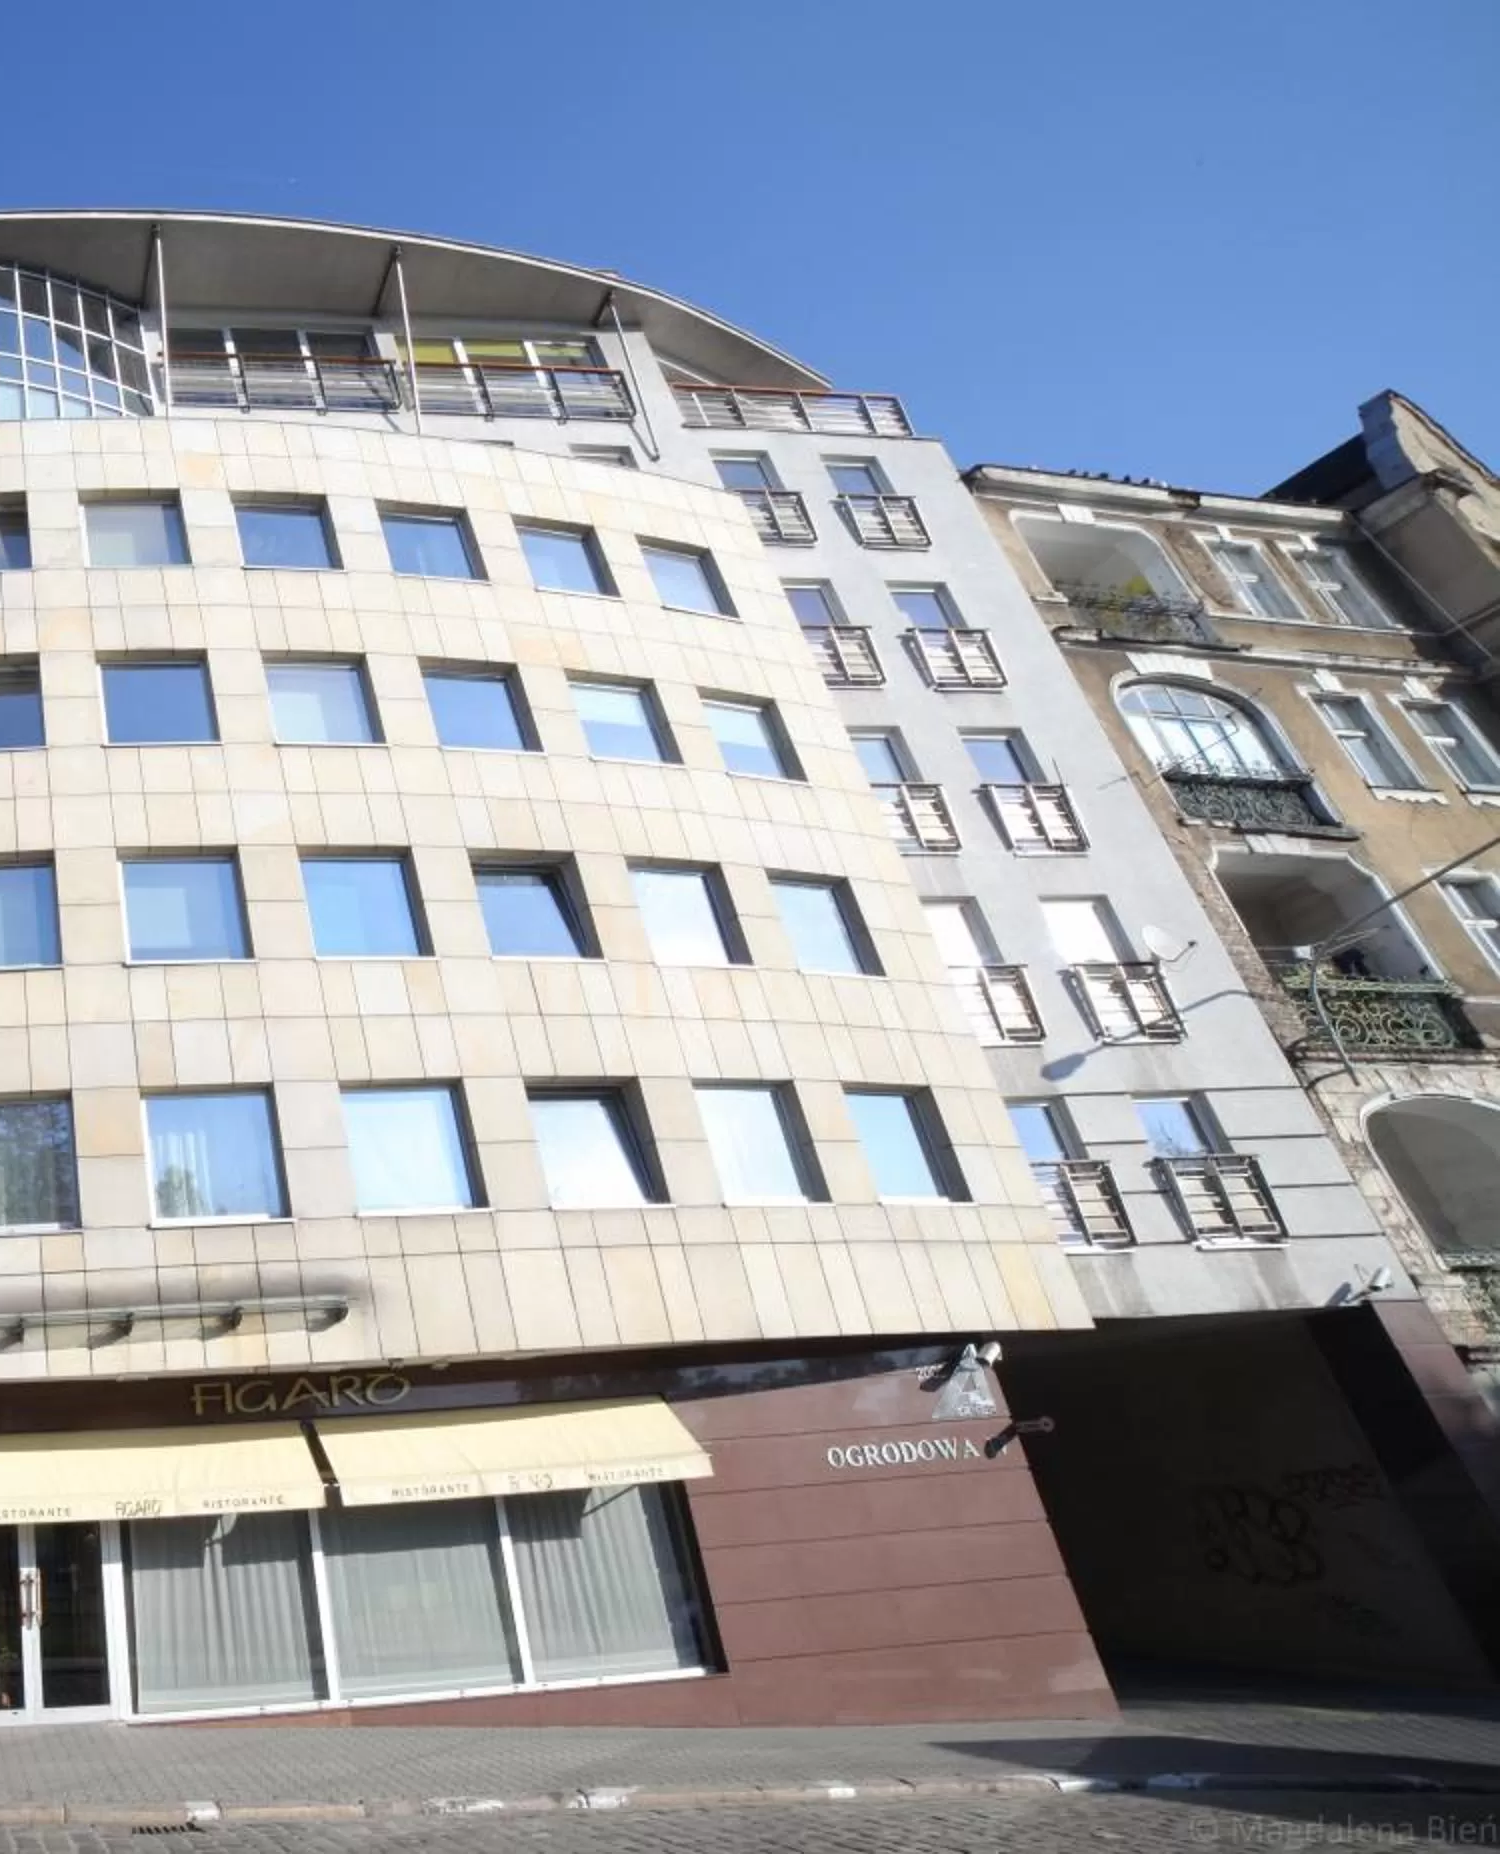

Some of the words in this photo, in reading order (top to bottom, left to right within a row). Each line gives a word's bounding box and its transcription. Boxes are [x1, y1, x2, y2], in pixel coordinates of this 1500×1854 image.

[191, 1372, 411, 1416] FIGARO
[827, 1437, 981, 1469] OGRODOWA
[202, 1494, 285, 1510] RISTORANTE
